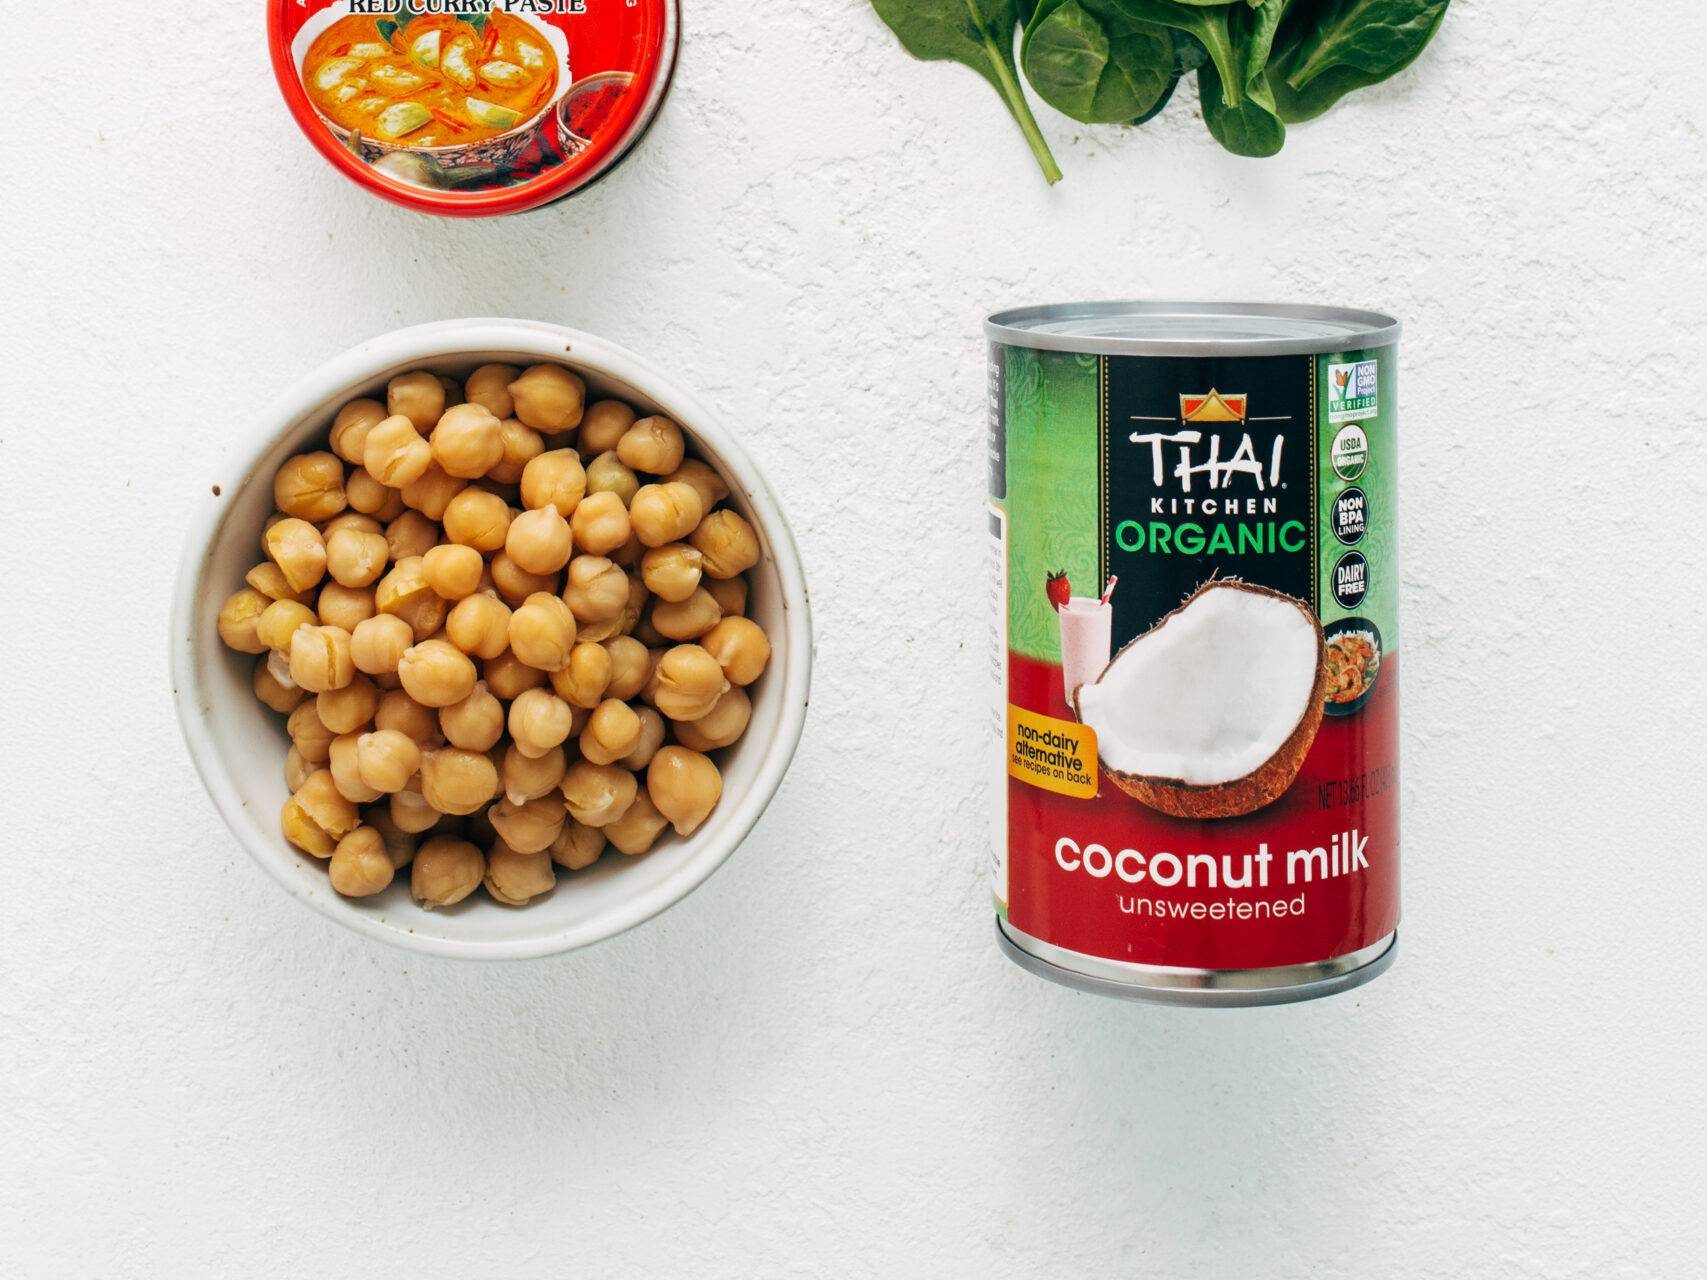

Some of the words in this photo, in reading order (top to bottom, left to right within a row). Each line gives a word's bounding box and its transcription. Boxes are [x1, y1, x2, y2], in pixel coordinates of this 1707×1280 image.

[1358, 365, 1375, 376] NON
[1357, 375, 1375, 386] GMO
[1332, 397, 1376, 410] VERIFIED
[1340, 438, 1361, 451] USDA
[1129, 430, 1284, 493] THAI
[1337, 454, 1364, 467] ORGANIC
[1151, 497, 1277, 515] KITCHEN
[1338, 497, 1363, 512] NON
[1340, 510, 1364, 526] BPA
[1115, 520, 1306, 555] ORGANIC
[1338, 523, 1364, 535] LINING
[1338, 563, 1365, 584] DAIRY
[1338, 581, 1365, 596] FREE
[1017, 723, 1079, 756] non-dairy
[1016, 740, 1083, 772] alternative
[1012, 754, 1022, 766] see
[1023, 759, 1051, 776] recipes
[1053, 768, 1064, 780] on
[1066, 770, 1092, 786] back
[1318, 781, 1337, 810] NET
[1055, 837, 1273, 888] coconut
[1286, 829, 1370, 885] milk
[1119, 892, 1305, 920] unsweetened
